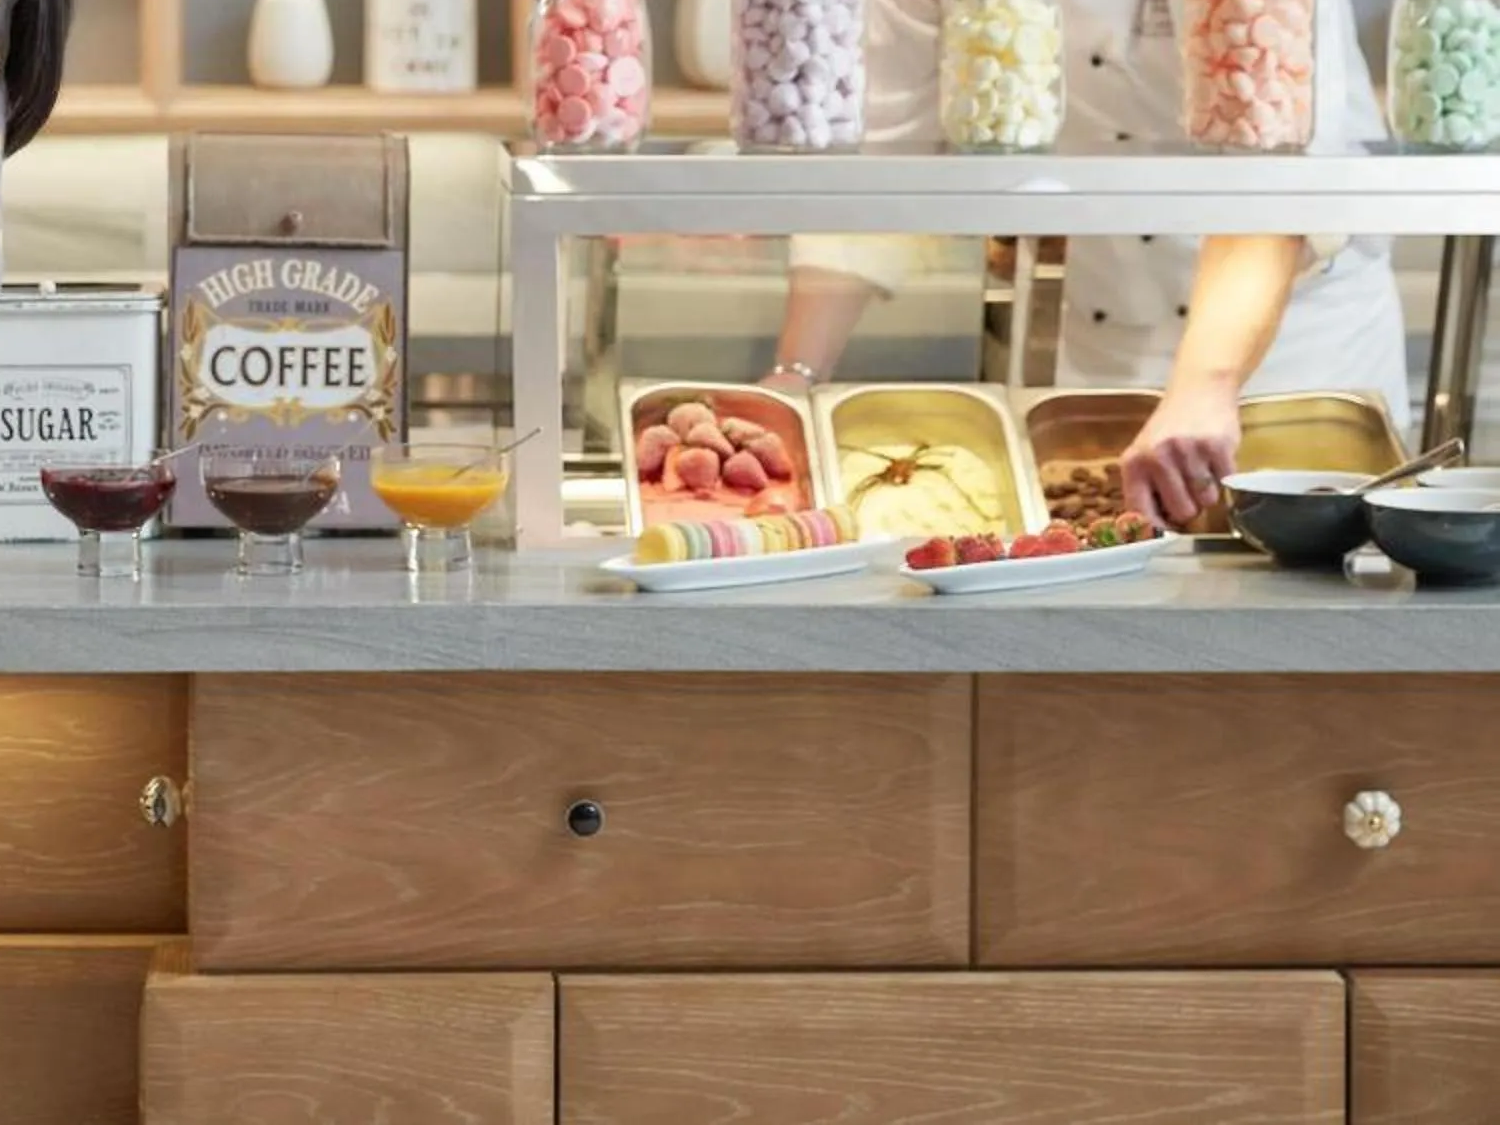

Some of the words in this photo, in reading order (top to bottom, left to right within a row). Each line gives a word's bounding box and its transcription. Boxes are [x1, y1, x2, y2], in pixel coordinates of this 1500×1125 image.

[197, 259, 274, 308] HIGH
[281, 259, 380, 314] GRADE
[249, 300, 288, 314] TRADE
[295, 300, 331, 314] MARK
[210, 345, 367, 387] COFFEE
[0, 407, 97, 442] SUGAR
